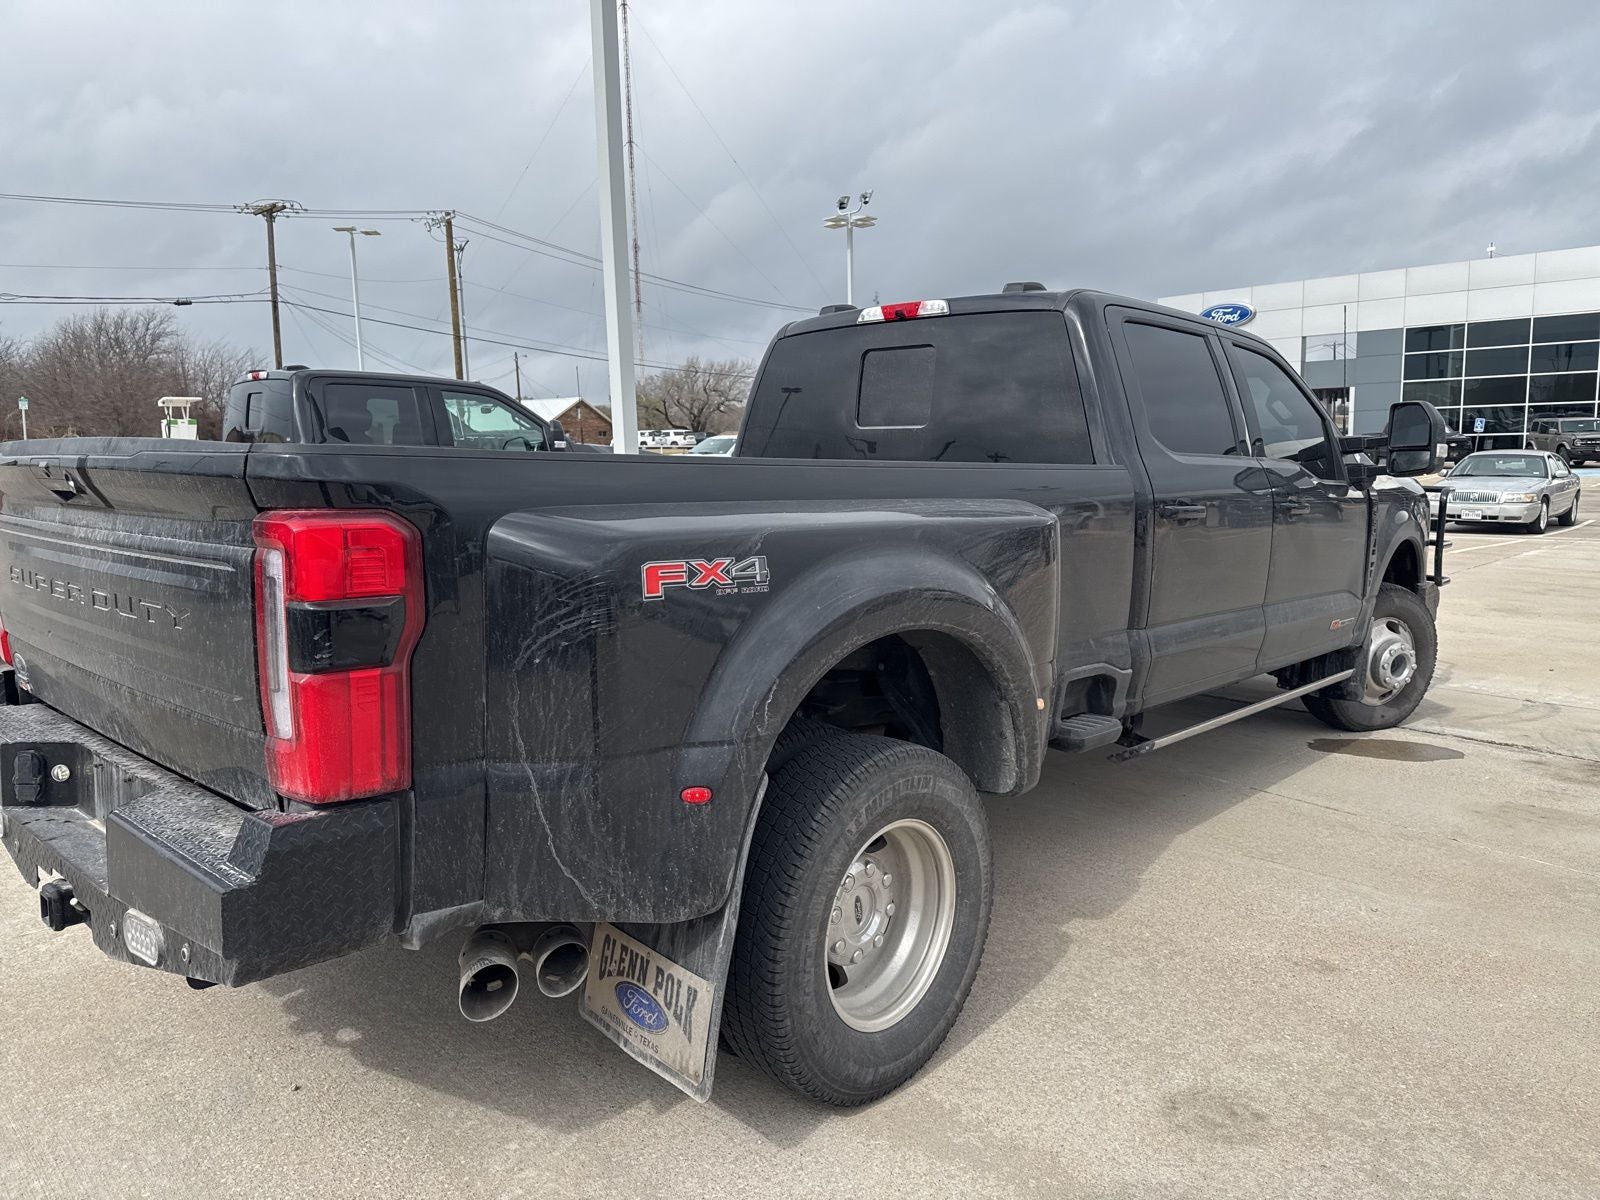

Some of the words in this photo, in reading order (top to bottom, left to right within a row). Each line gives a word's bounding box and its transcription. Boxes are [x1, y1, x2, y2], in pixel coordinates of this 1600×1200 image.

[1210, 307, 1242, 323] Ford
[10, 564, 85, 605] SUPER
[92, 587, 191, 631] DUTY
[641, 555, 771, 601] FX4
[599, 933, 650, 987] GLENN
[651, 964, 699, 1045] POLK
[623, 988, 659, 1026] Ford
[639, 1034, 660, 1055] TEXAS
